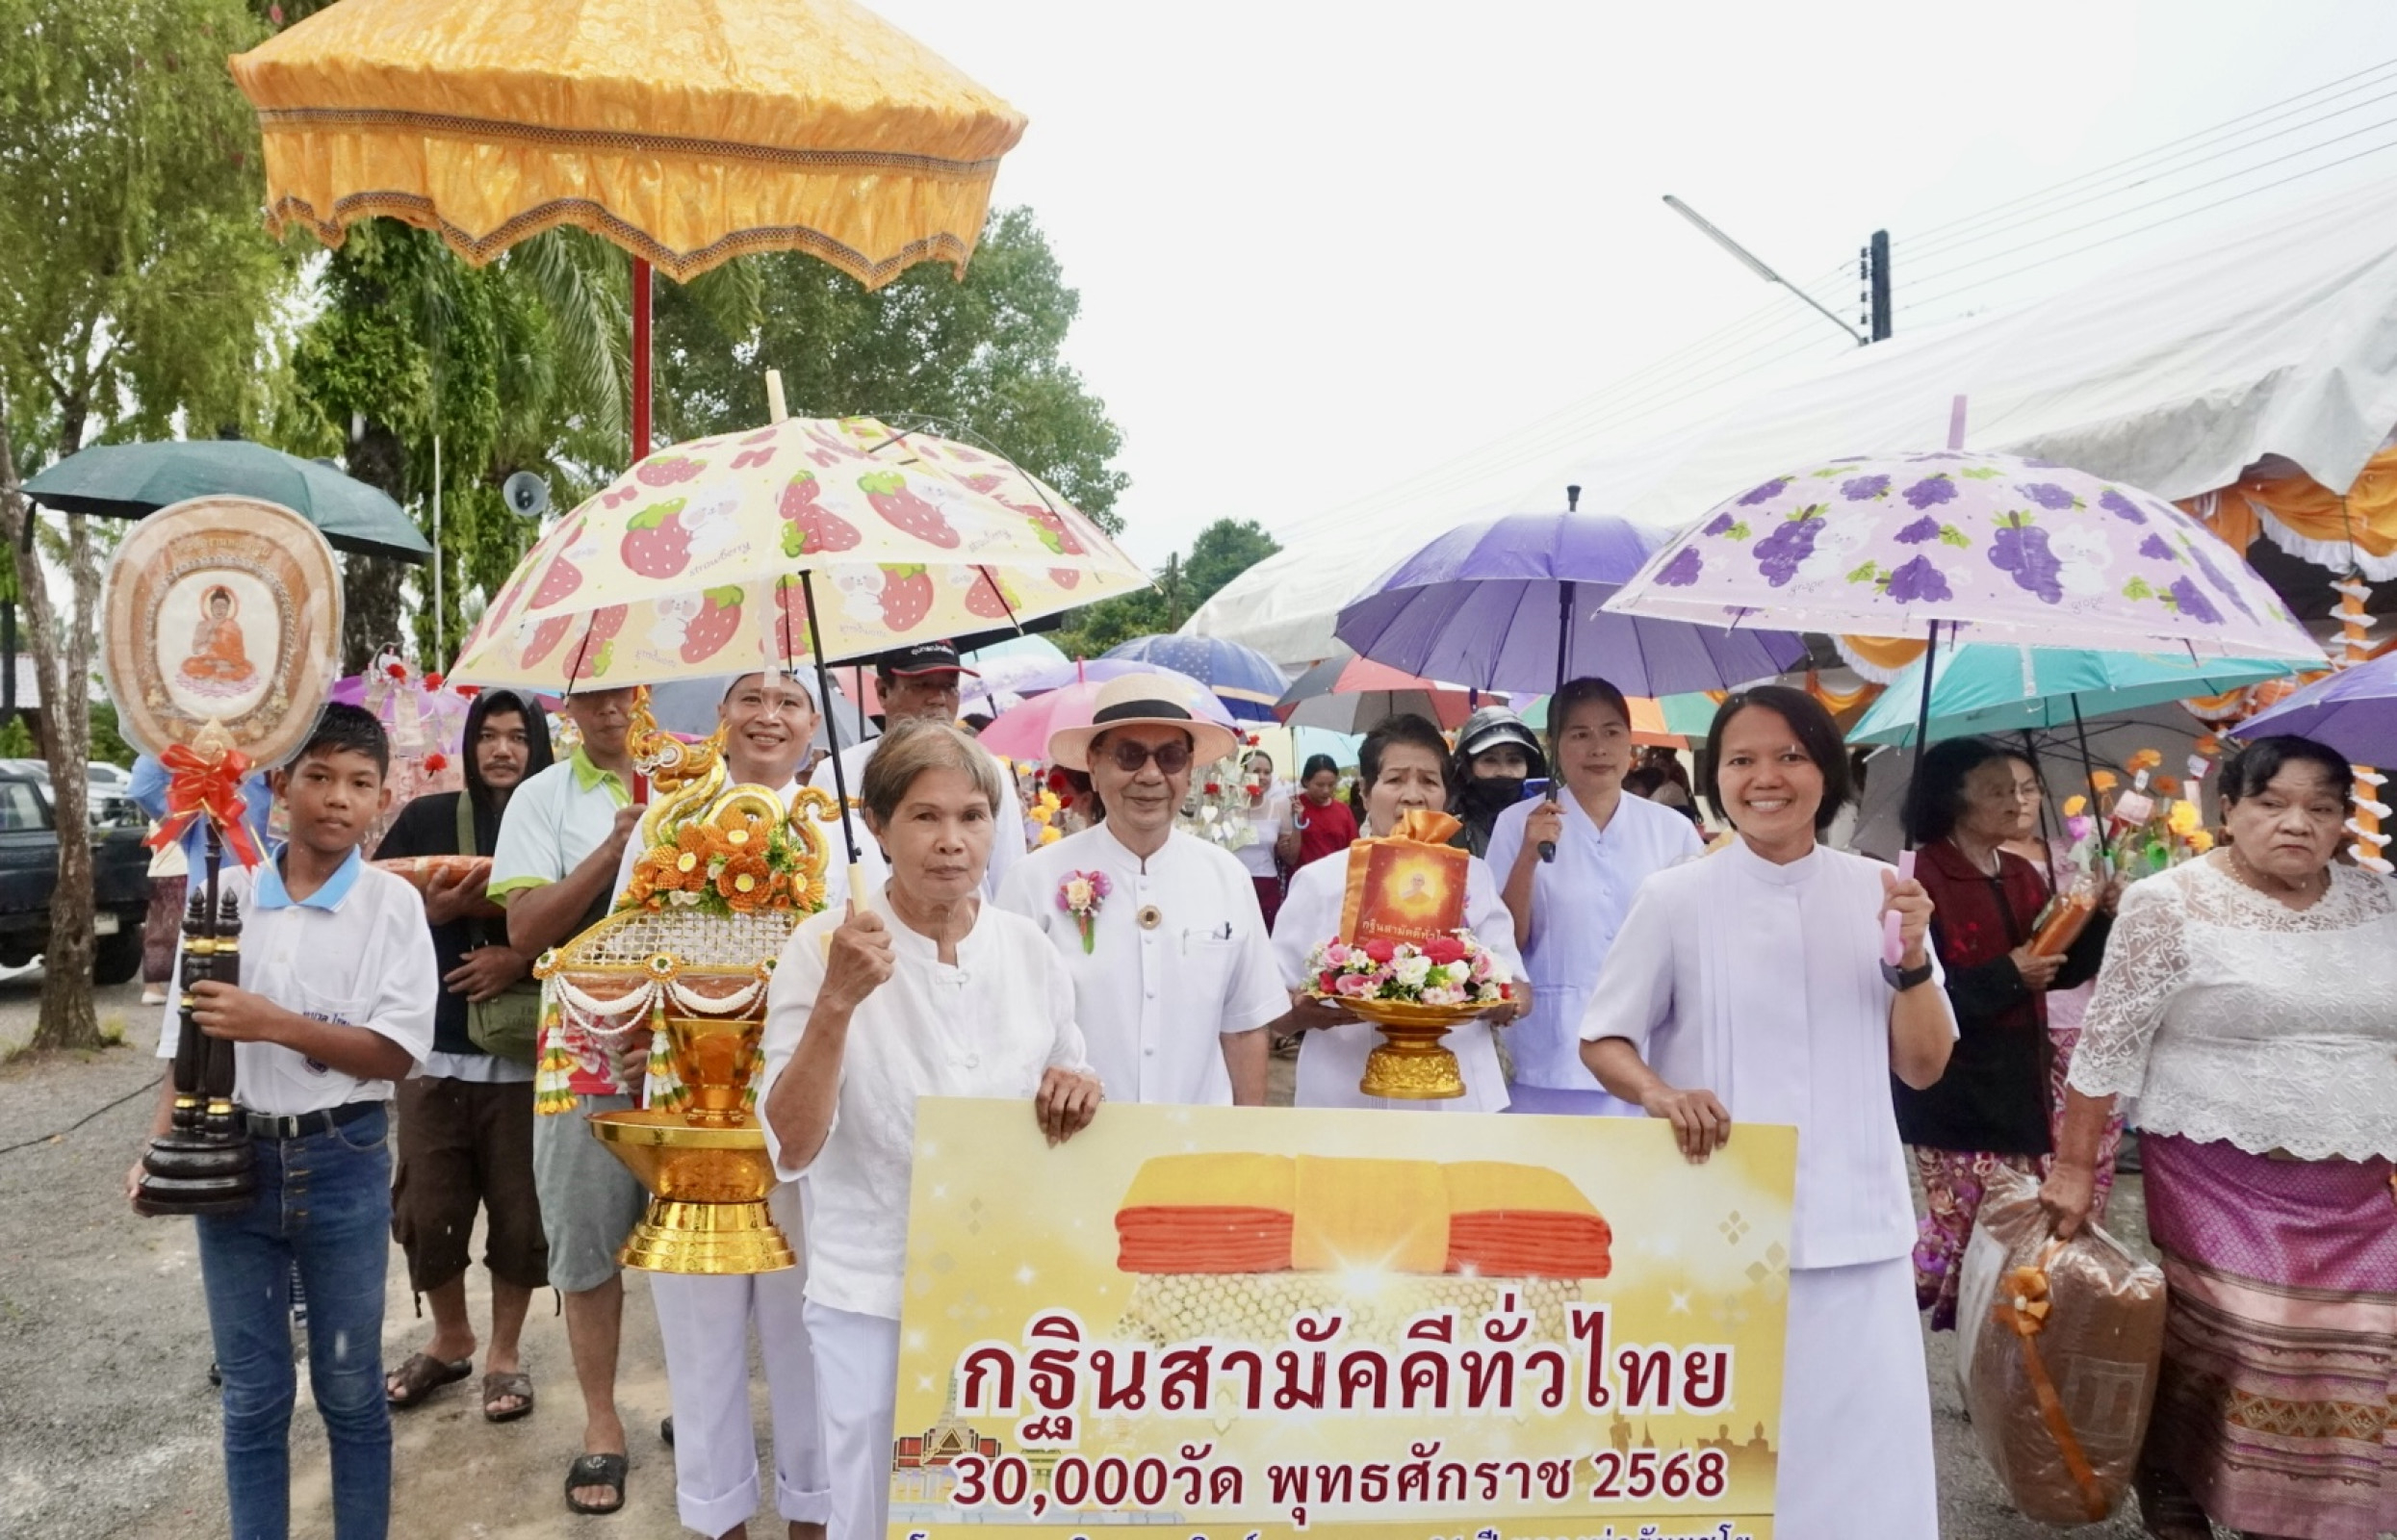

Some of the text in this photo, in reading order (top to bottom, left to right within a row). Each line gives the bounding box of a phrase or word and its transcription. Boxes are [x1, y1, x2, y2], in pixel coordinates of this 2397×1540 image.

[963, 1293, 1728, 1441] กฐินสามัคคีทั่วไทย
[952, 1442, 1725, 1527] 30,000วัด พุทธศักราช 2568
